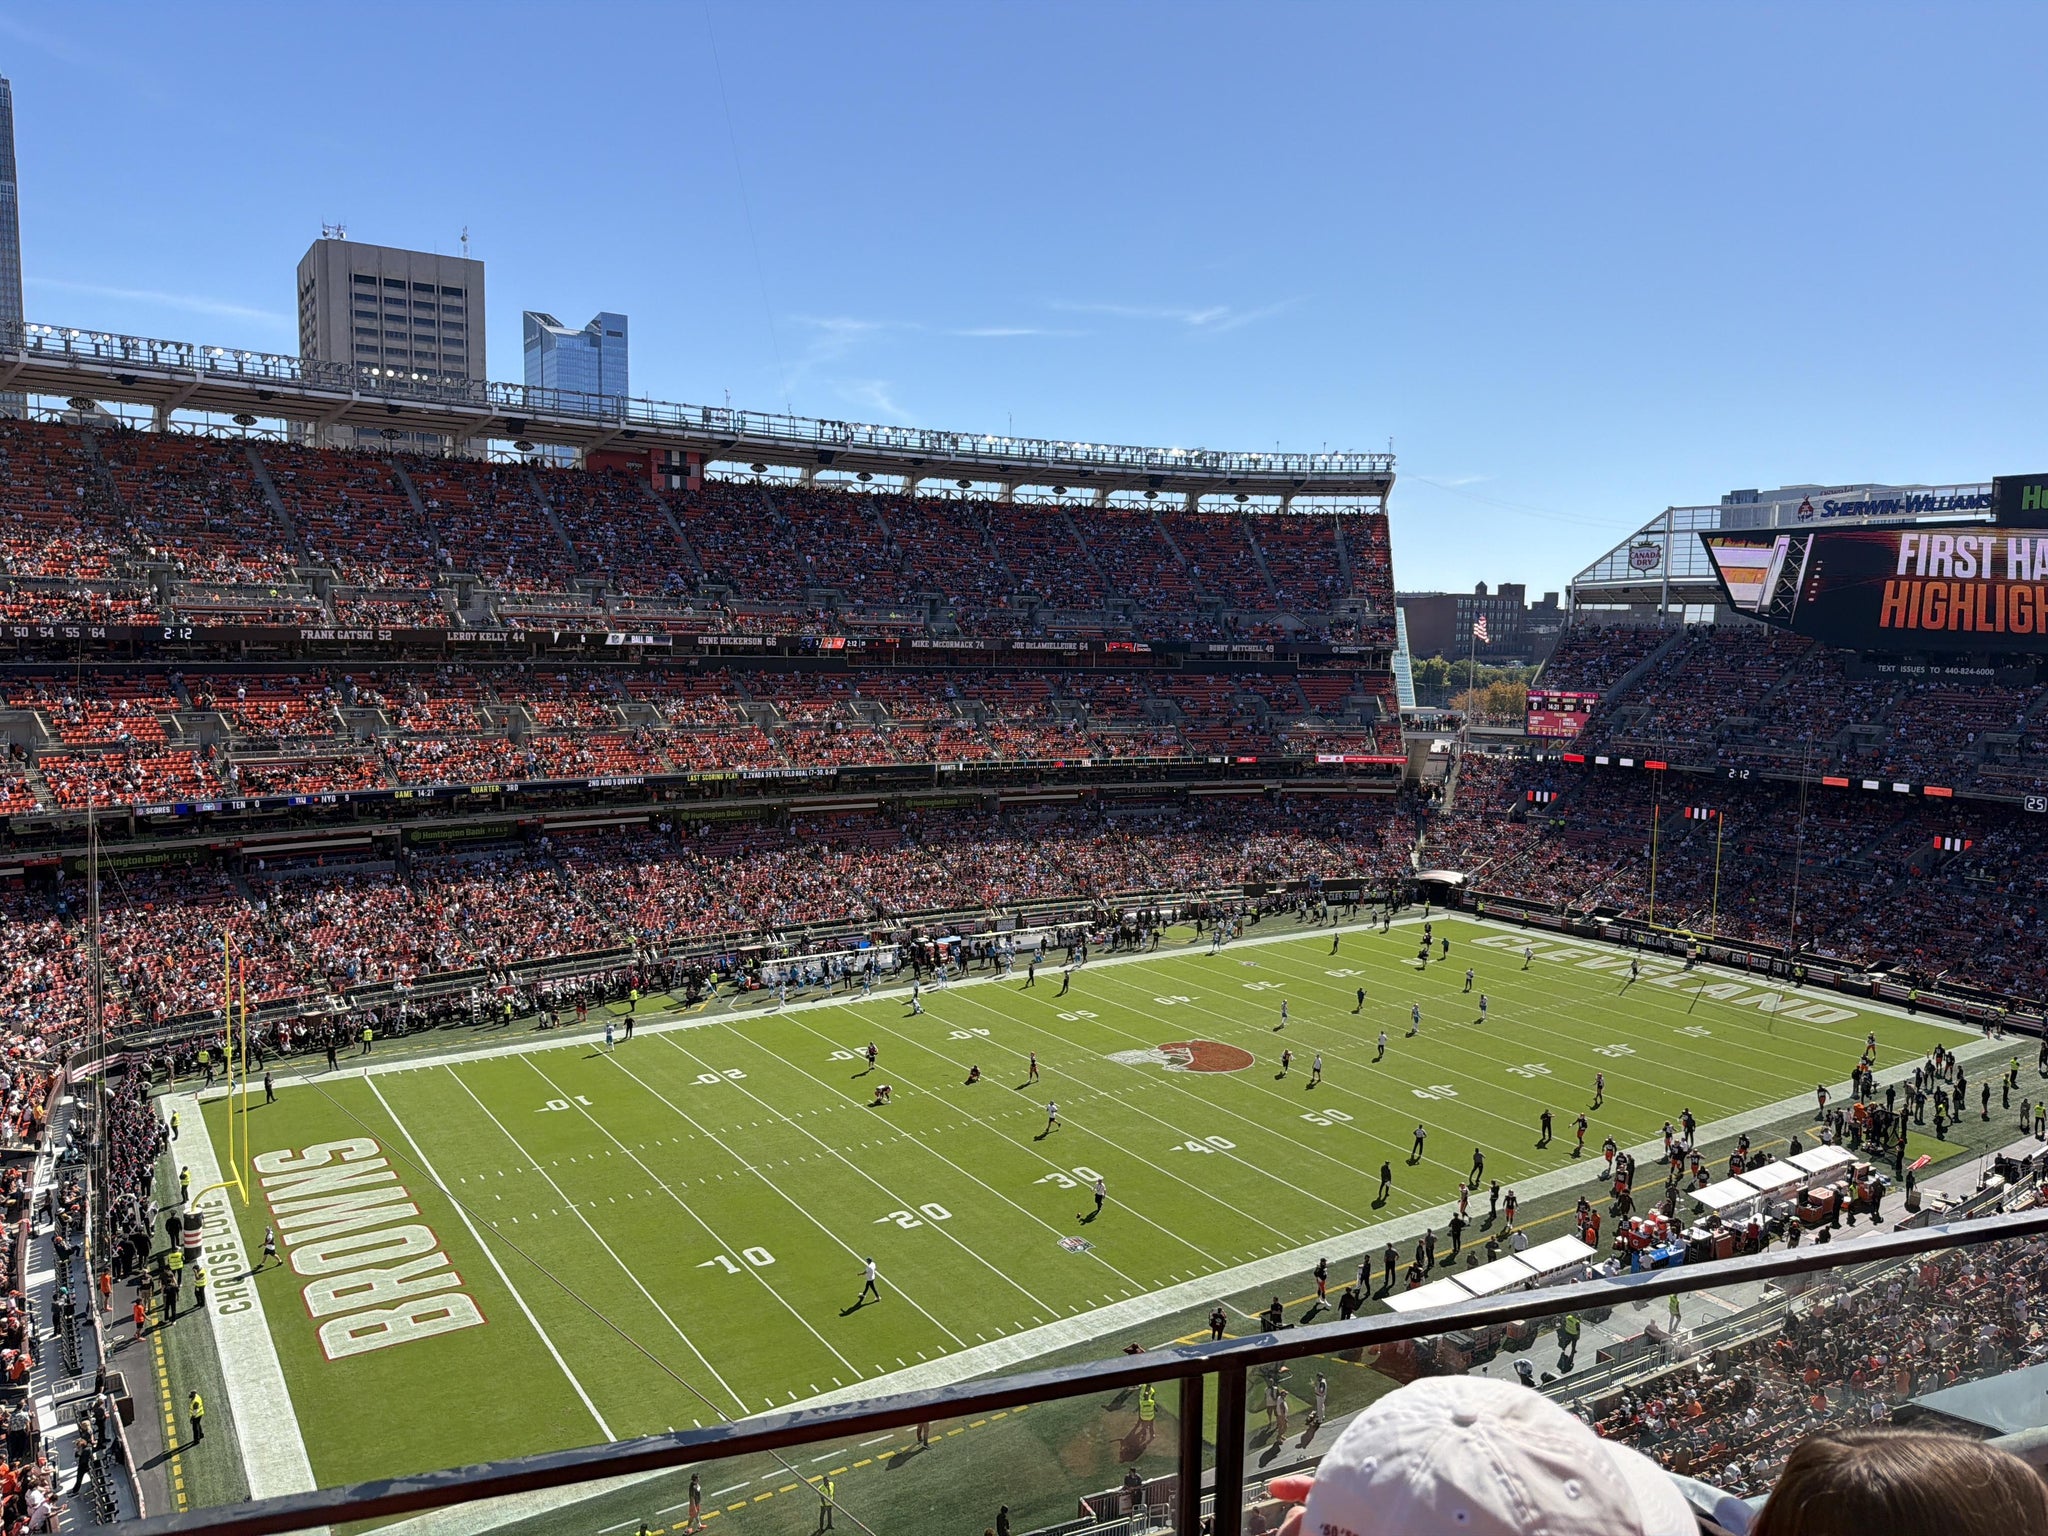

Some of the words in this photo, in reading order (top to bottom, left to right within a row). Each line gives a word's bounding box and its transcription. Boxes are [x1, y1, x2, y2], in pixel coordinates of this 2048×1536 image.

[2021, 485, 2048, 510] H
[1629, 551, 1661, 559] CANADA
[1896, 533, 1996, 579] FIRST
[9, 627, 29, 638] '50
[36, 627, 54, 638] '54
[61, 627, 80, 638] '55
[88, 627, 106, 638] '64
[164, 628, 192, 640] 2:12
[300, 630, 336, 640] FRANK
[337, 630, 373, 640] GATSKI
[378, 630, 392, 641] 52
[447, 632, 477, 641] LEROY
[479, 632, 508, 641] KELLY
[512, 632, 525, 642] 44
[698, 636, 718, 645] GENE
[720, 636, 762, 646] HICKERSON
[766, 637, 777, 646] 66
[911, 640, 930, 648] MIKE
[975, 641, 984, 649] 74
[1012, 641, 1025, 649] JOE
[1079, 642, 1088, 650] 64
[1232, 644, 1264, 652] MITCHELL
[1878, 664, 1895, 673] TEXT
[1900, 665, 1925, 674] ISSUES
[1930, 666, 1940, 674] TO
[1945, 667, 1995, 676] 440-824-6000
[1728, 768, 1750, 780] 2:12
[394, 790, 413, 799] GAME
[232, 801, 246, 809] TEN
[254, 800, 260, 808] 0
[2027, 797, 2044, 810] 25
[146, 806, 171, 815] SCORES
[422, 829, 464, 840] Huntington
[466, 827, 485, 836] Bank
[146, 853, 170, 863] Bank
[173, 851, 199, 860] FIELD
[1471, 934, 1860, 1024] CLEVELAND
[1056, 1010, 1099, 1022] 50
[953, 1027, 991, 1040] 40
[1592, 1043, 1636, 1058] 20
[698, 1068, 748, 1085] 20
[1506, 1063, 1552, 1079] 30
[1411, 1085, 1459, 1101] 40
[545, 1094, 593, 1111] 10
[1300, 1108, 1354, 1126] 50
[1183, 1135, 1237, 1154] 40
[1045, 1165, 1104, 1189] 30
[199, 1199, 231, 1240] LOVE
[889, 1202, 953, 1230] 20
[252, 1137, 490, 1363] BROWNS
[713, 1246, 777, 1274] 10
[204, 1241, 252, 1315] CHOOSE
